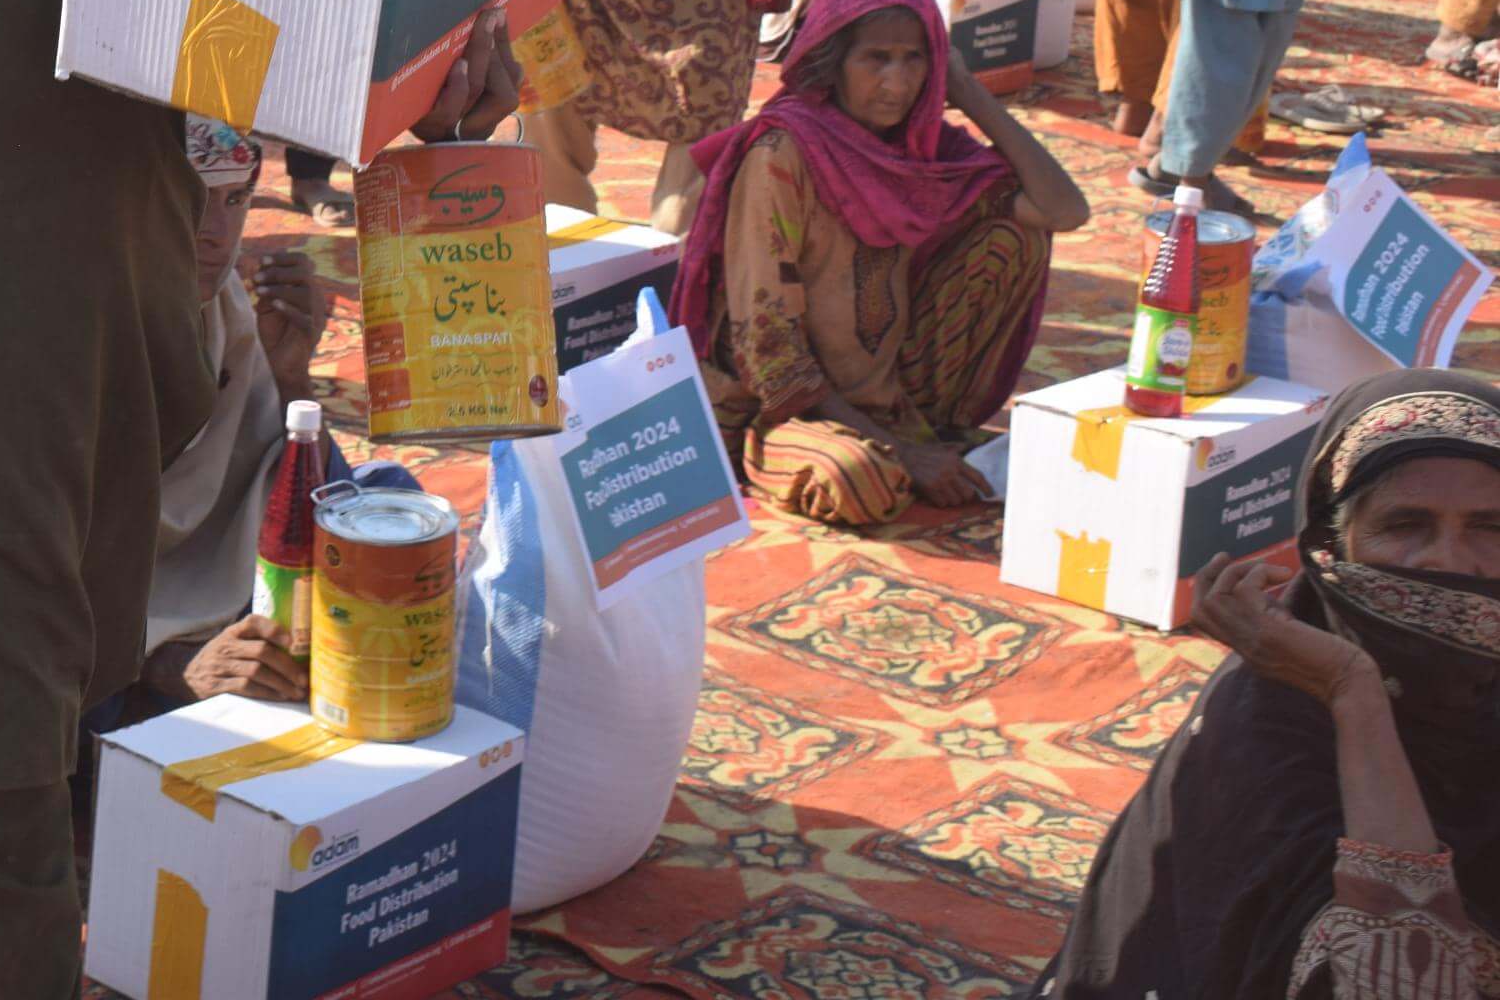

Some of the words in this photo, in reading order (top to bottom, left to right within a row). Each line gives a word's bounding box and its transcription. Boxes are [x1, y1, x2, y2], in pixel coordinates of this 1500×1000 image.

[420, 232, 513, 265] waseb
[1373, 231, 1409, 275] 2024
[430, 331, 512, 348] BANASPATI
[631, 415, 681, 451] 2024
[312, 835, 359, 867] adam
[347, 861, 419, 905] Ramadhan
[420, 839, 458, 873] 2024
[340, 901, 376, 934] Food
[378, 868, 459, 918] Distribution
[368, 908, 430, 948] Pakistan
